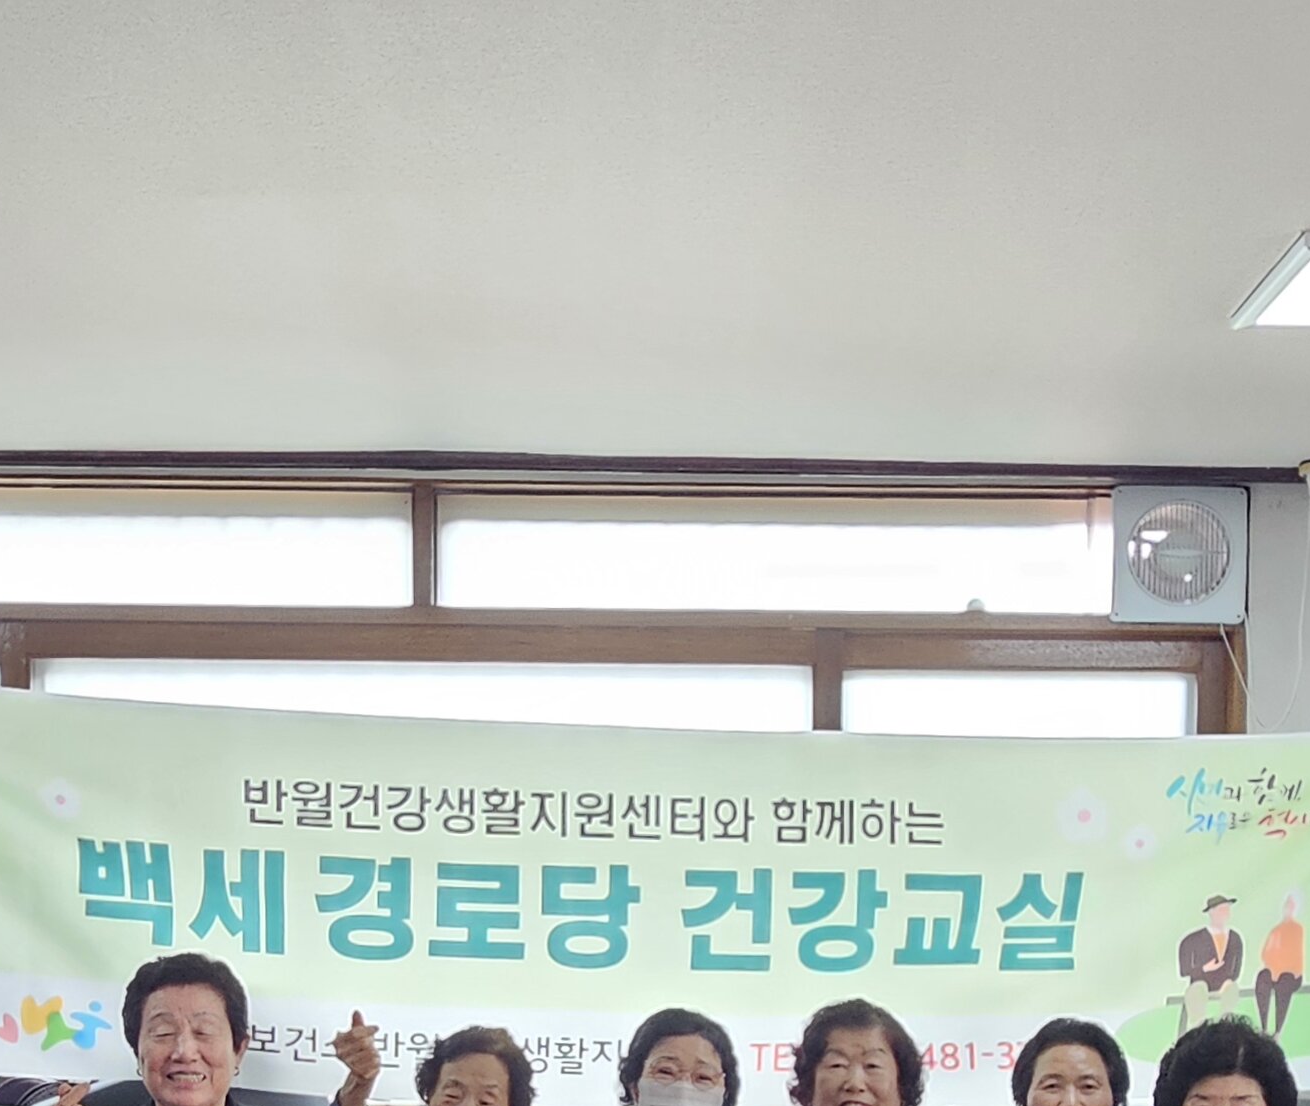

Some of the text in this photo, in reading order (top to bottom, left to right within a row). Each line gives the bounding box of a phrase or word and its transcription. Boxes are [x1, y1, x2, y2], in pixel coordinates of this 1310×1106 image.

[242, 777, 944, 847] 반월건강생활지원센터와 함께하는
[1248, 768, 1302, 805] 함께
[77, 837, 1085, 974] 백세 경로당 건강교실
[750, 1042, 796, 1073] TE
